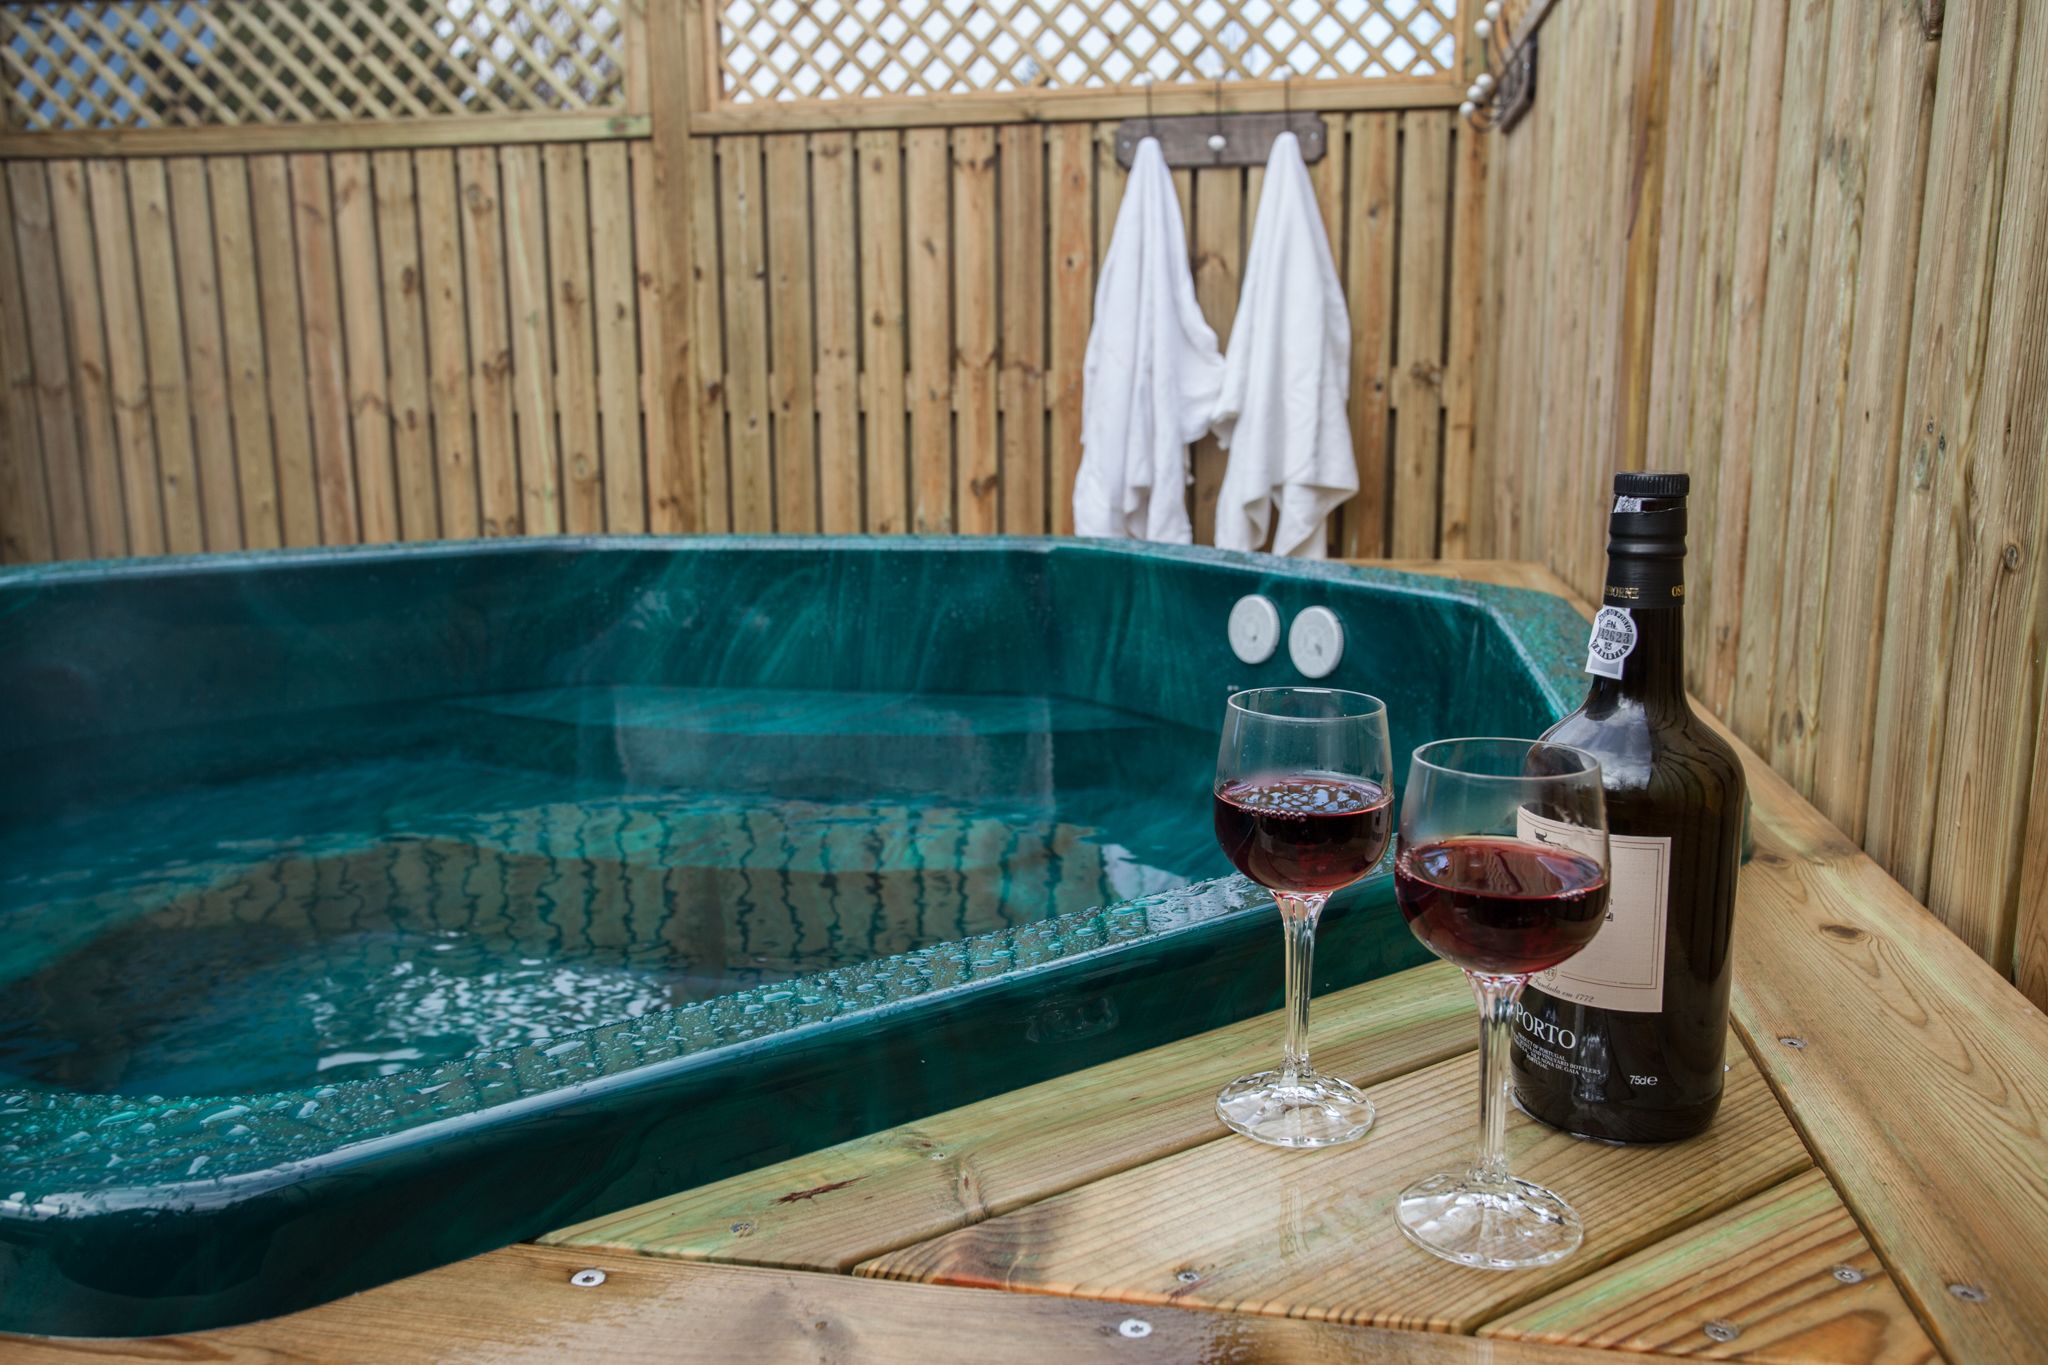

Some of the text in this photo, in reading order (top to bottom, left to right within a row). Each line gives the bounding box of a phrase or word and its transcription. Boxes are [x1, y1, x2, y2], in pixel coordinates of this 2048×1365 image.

[1575, 993, 1595, 1002] 1772
[1516, 1001, 1576, 1050] PORTO
[1542, 1052, 1569, 1067] VINEYARD
[1569, 1063, 1601, 1075] BOTTLERS
[1564, 1066, 1580, 1075] GAIA
